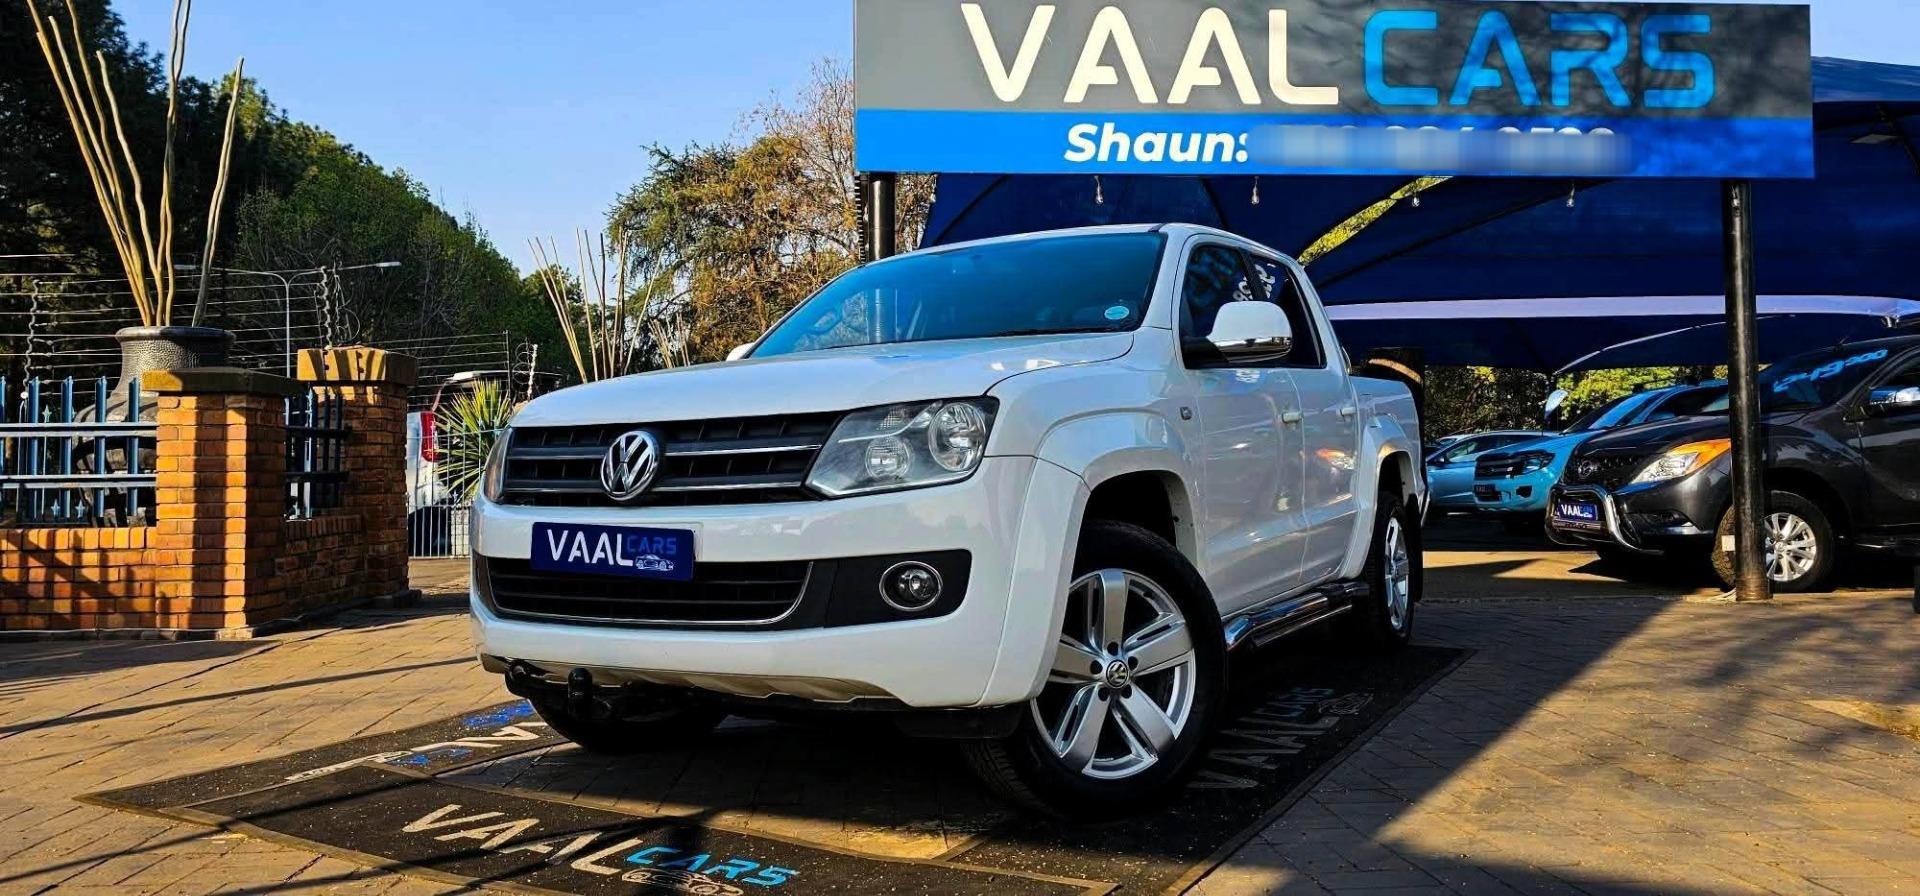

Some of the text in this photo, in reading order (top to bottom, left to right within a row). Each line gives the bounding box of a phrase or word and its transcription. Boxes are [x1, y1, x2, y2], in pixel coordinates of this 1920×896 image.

[961, 3, 1715, 109] VAAL CARS
[547, 529, 677, 567] VAAL CARS
[402, 804, 800, 887] VAAL CARS
